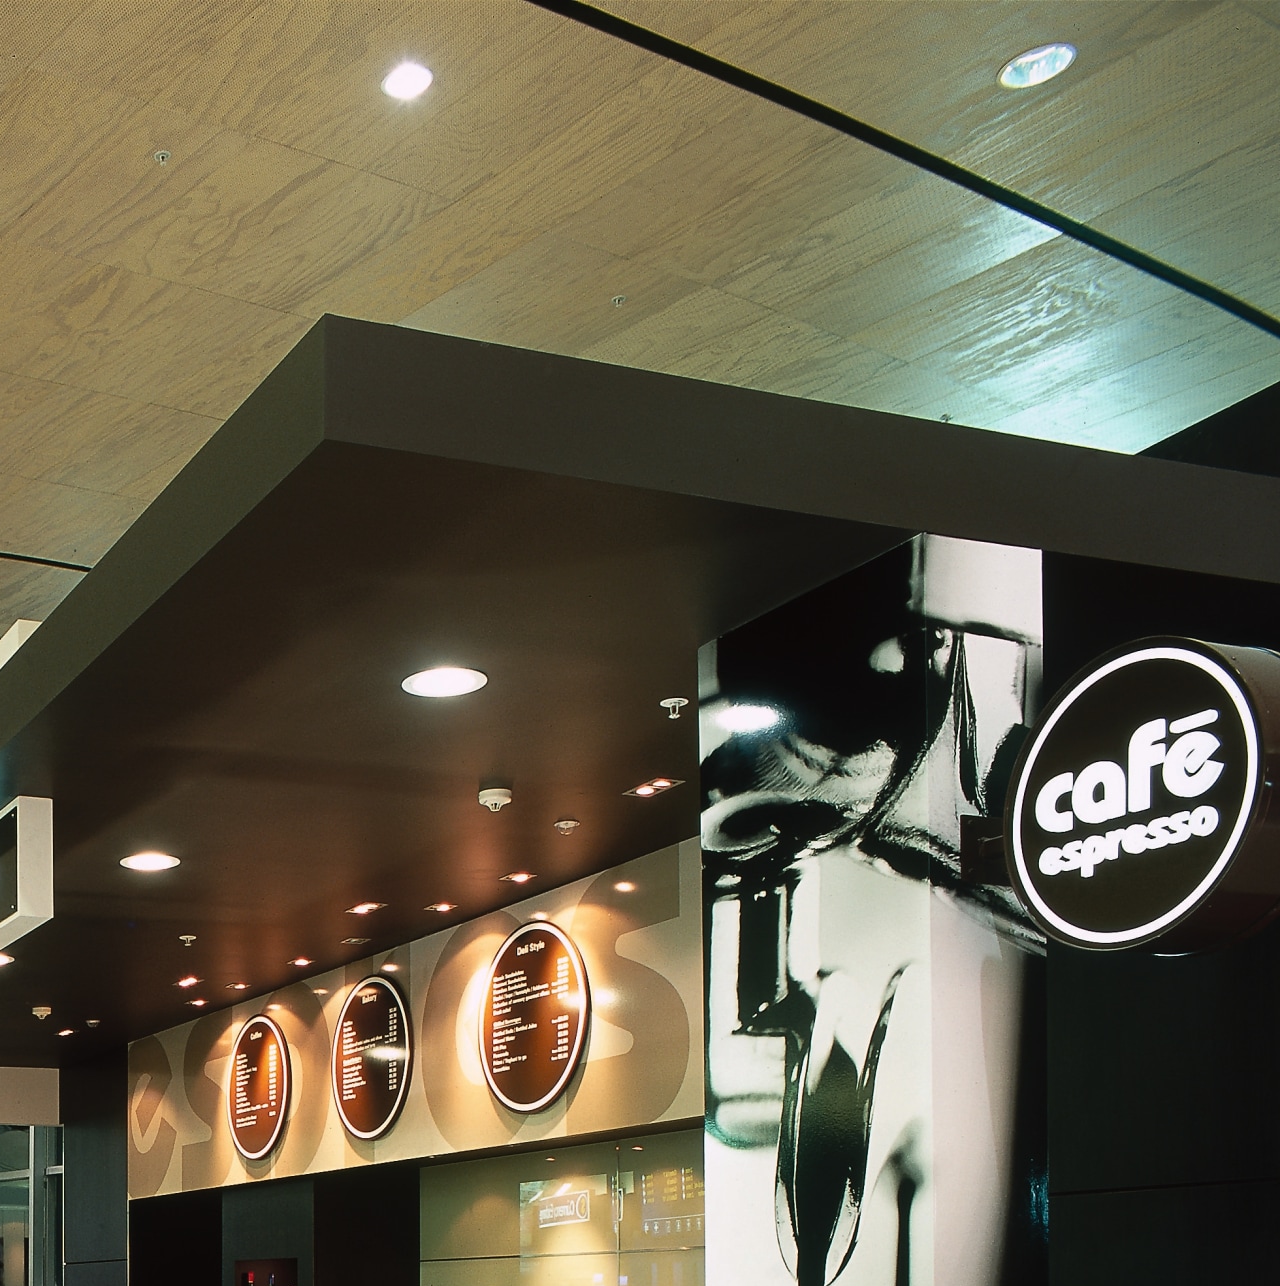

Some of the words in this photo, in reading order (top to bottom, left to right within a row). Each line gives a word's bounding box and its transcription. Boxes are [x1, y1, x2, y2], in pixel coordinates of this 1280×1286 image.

[1035, 708, 1225, 833] café
[1038, 805, 1219, 878] espresso
[516, 944, 529, 956] Deli
[529, 941, 545, 952] Style
[362, 994, 377, 1004] Bakery
[250, 1032, 262, 1040] Coffee
